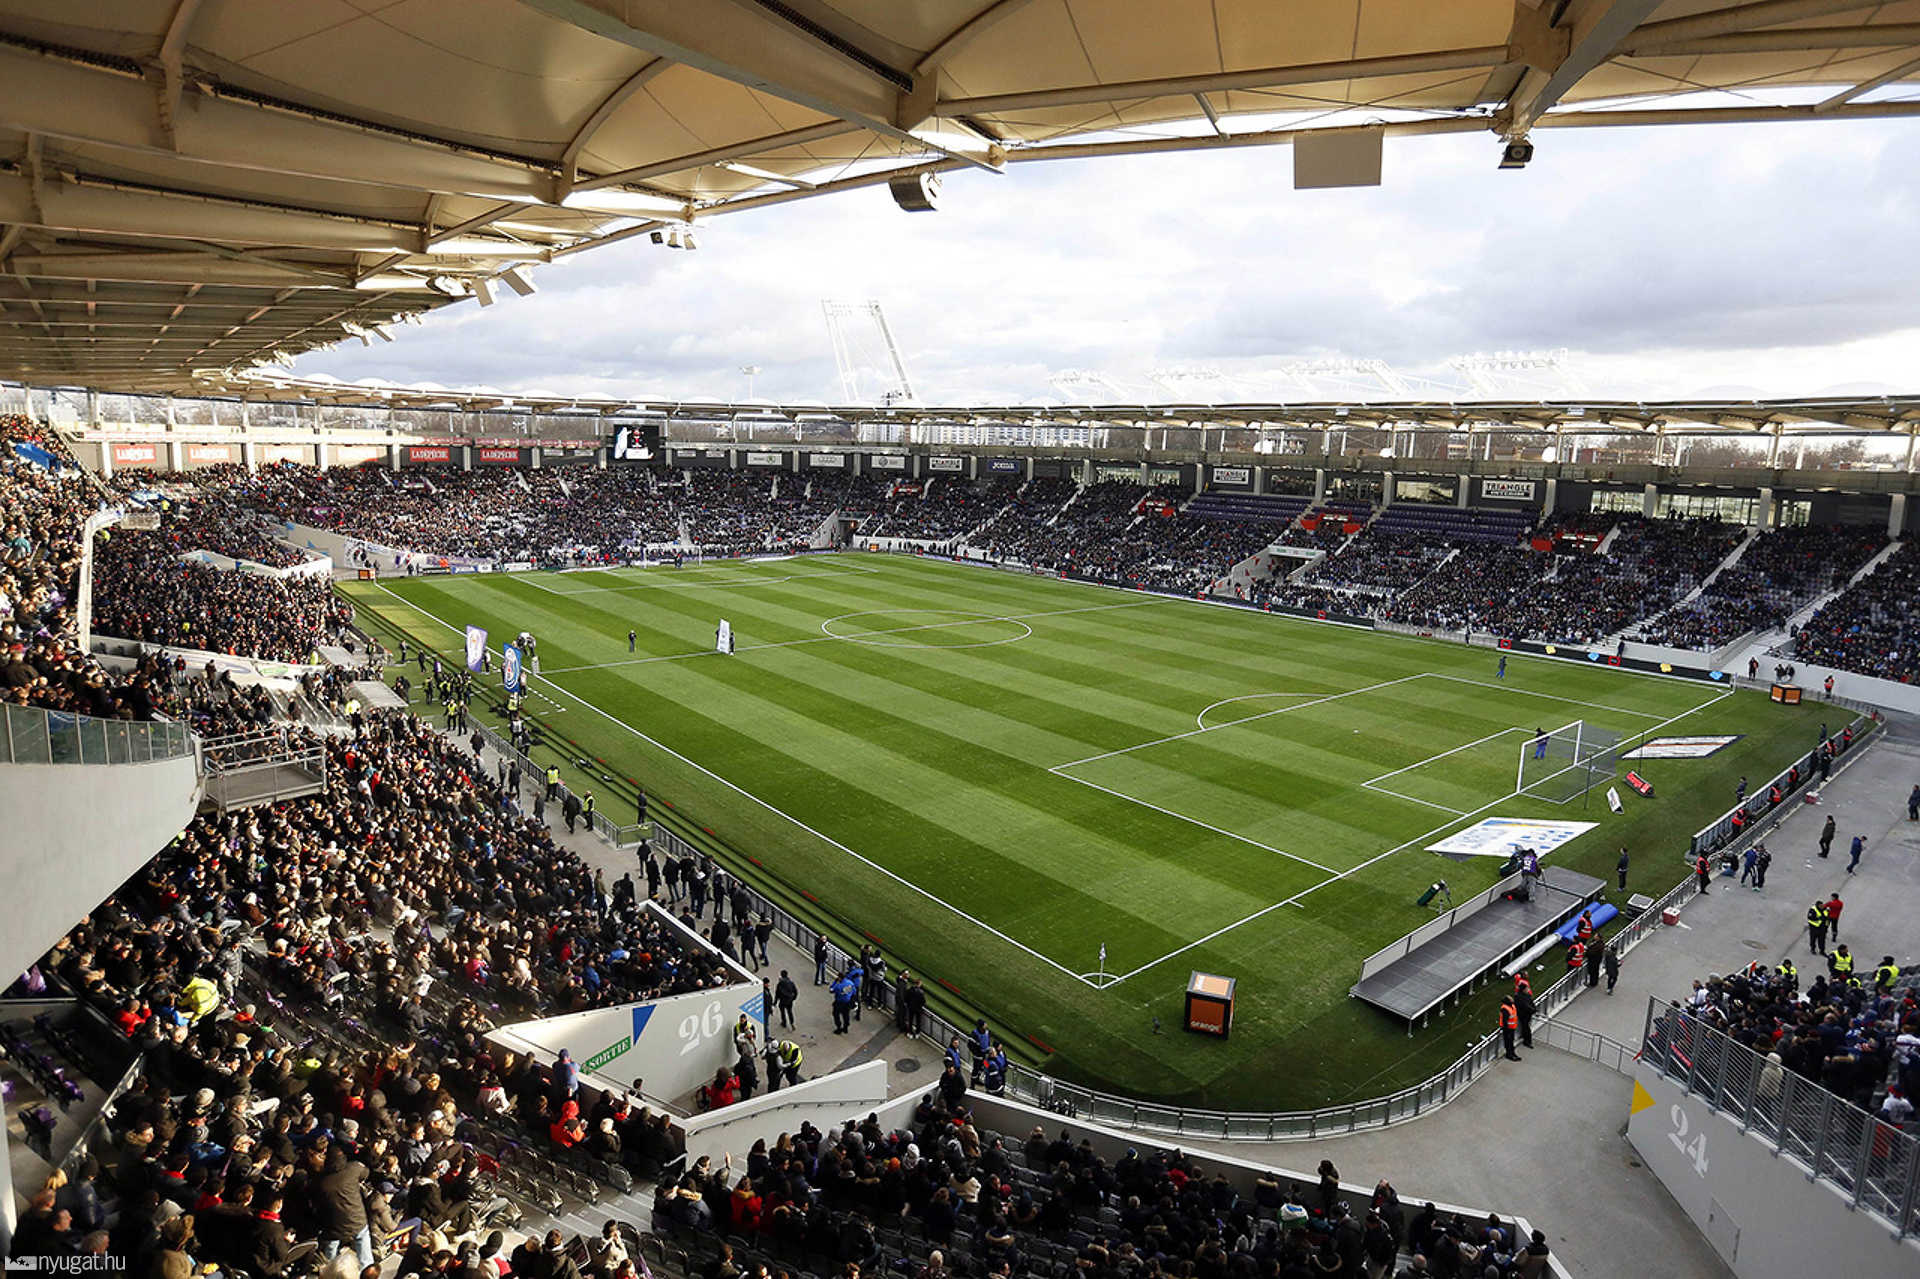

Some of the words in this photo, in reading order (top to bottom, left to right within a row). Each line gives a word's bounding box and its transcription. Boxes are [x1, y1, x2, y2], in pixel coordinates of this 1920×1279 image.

[1486, 482, 1531, 491] TRIANGLE
[679, 1001, 723, 1056] 26
[589, 1039, 630, 1069] SORTIE
[1667, 1103, 1709, 1179] 24
